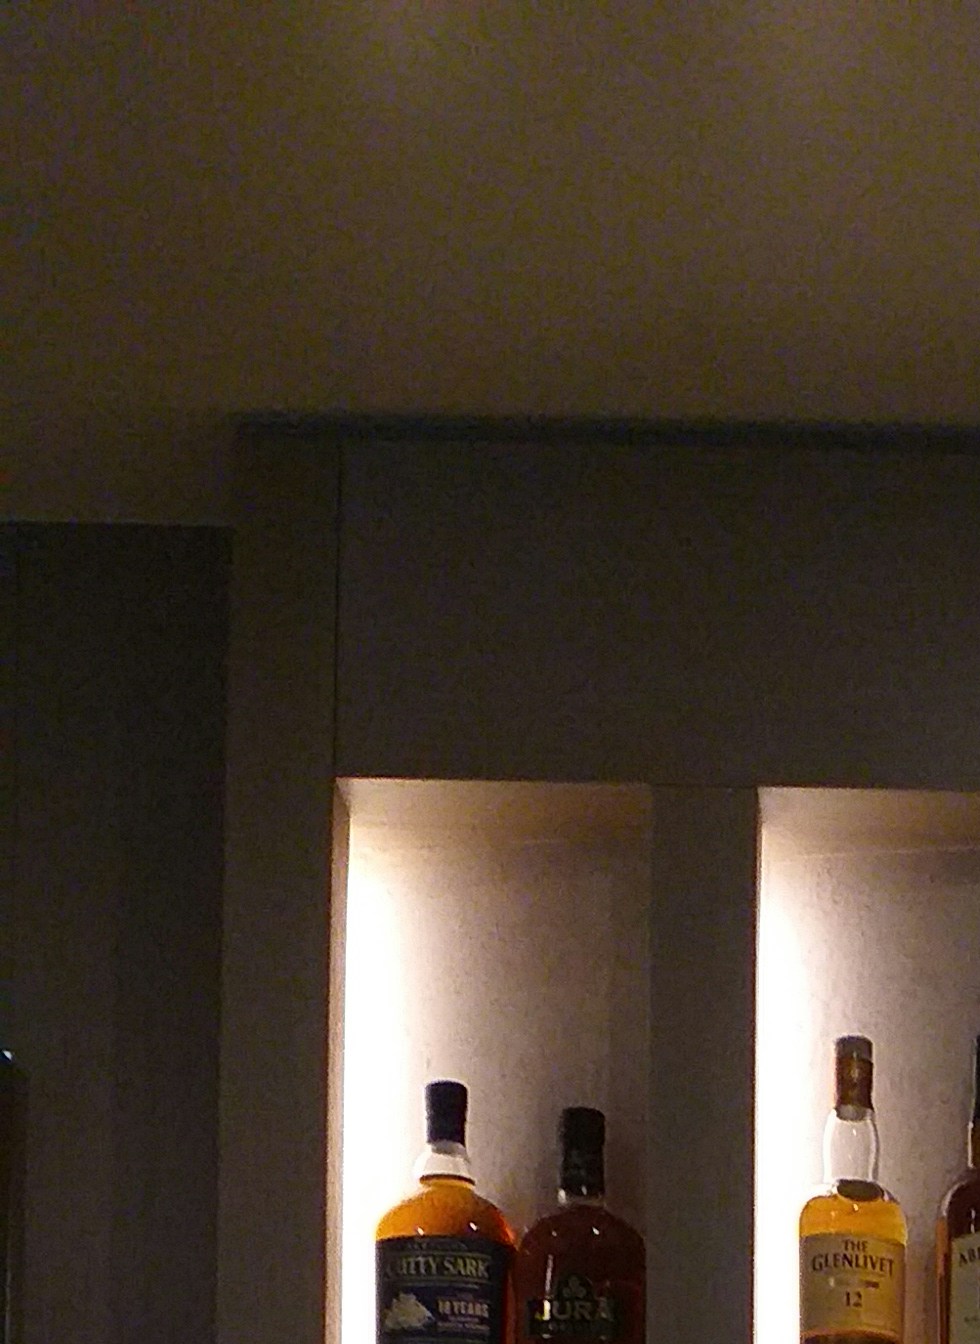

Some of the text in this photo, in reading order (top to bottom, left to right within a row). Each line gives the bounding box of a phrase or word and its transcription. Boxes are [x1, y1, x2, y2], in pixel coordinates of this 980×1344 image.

[842, 1238, 869, 1253] THE
[443, 1256, 490, 1280] SARK
[812, 1252, 895, 1277] GLENLIVET
[535, 1298, 615, 1322] JURA
[845, 1291, 863, 1308] 12
